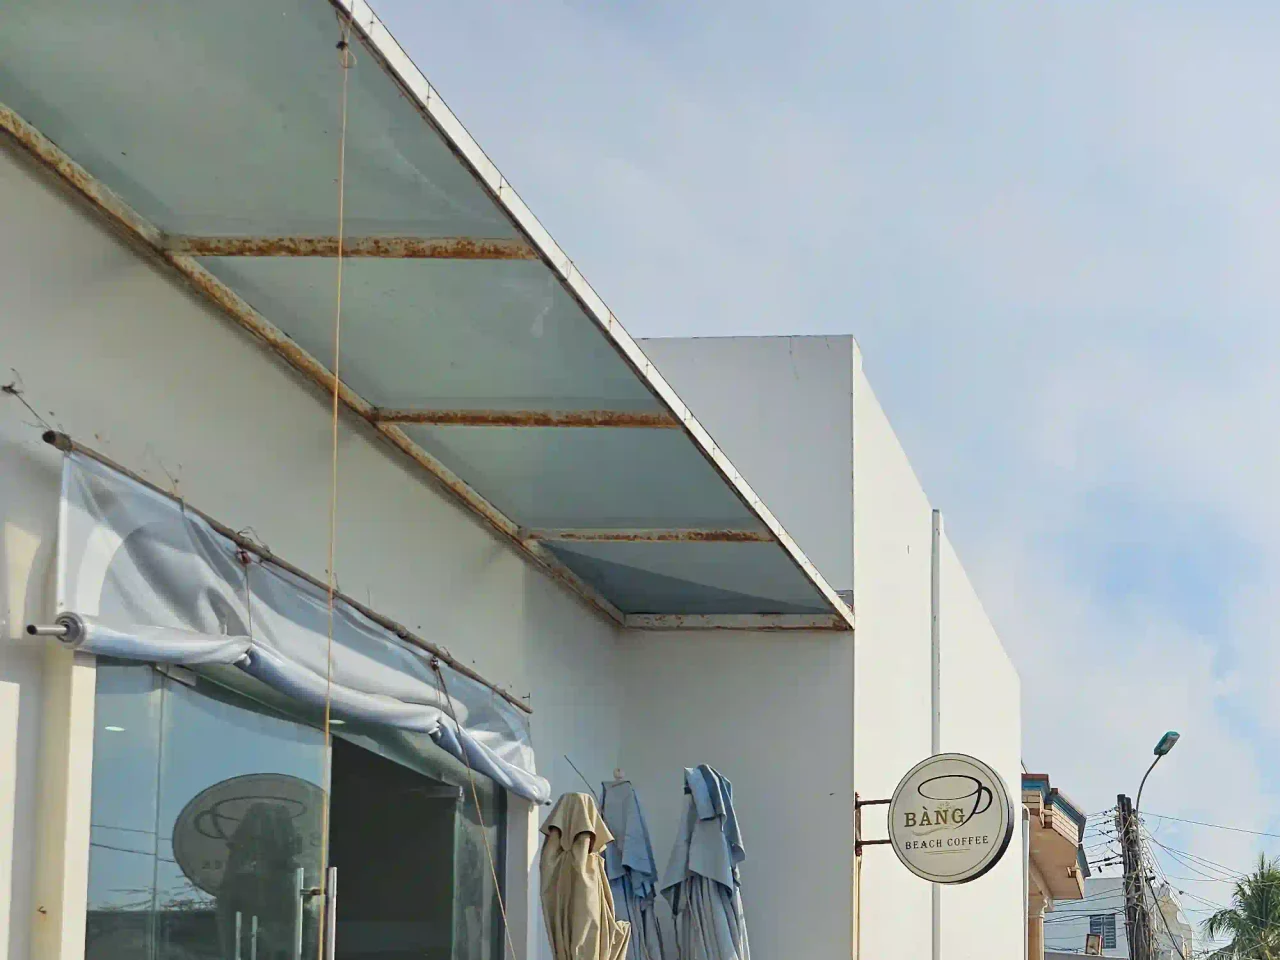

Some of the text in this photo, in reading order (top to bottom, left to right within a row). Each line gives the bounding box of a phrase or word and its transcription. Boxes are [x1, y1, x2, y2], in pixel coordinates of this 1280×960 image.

[904, 807, 965, 828] BÀNG
[905, 835, 989, 850] BEACH COFFEE
